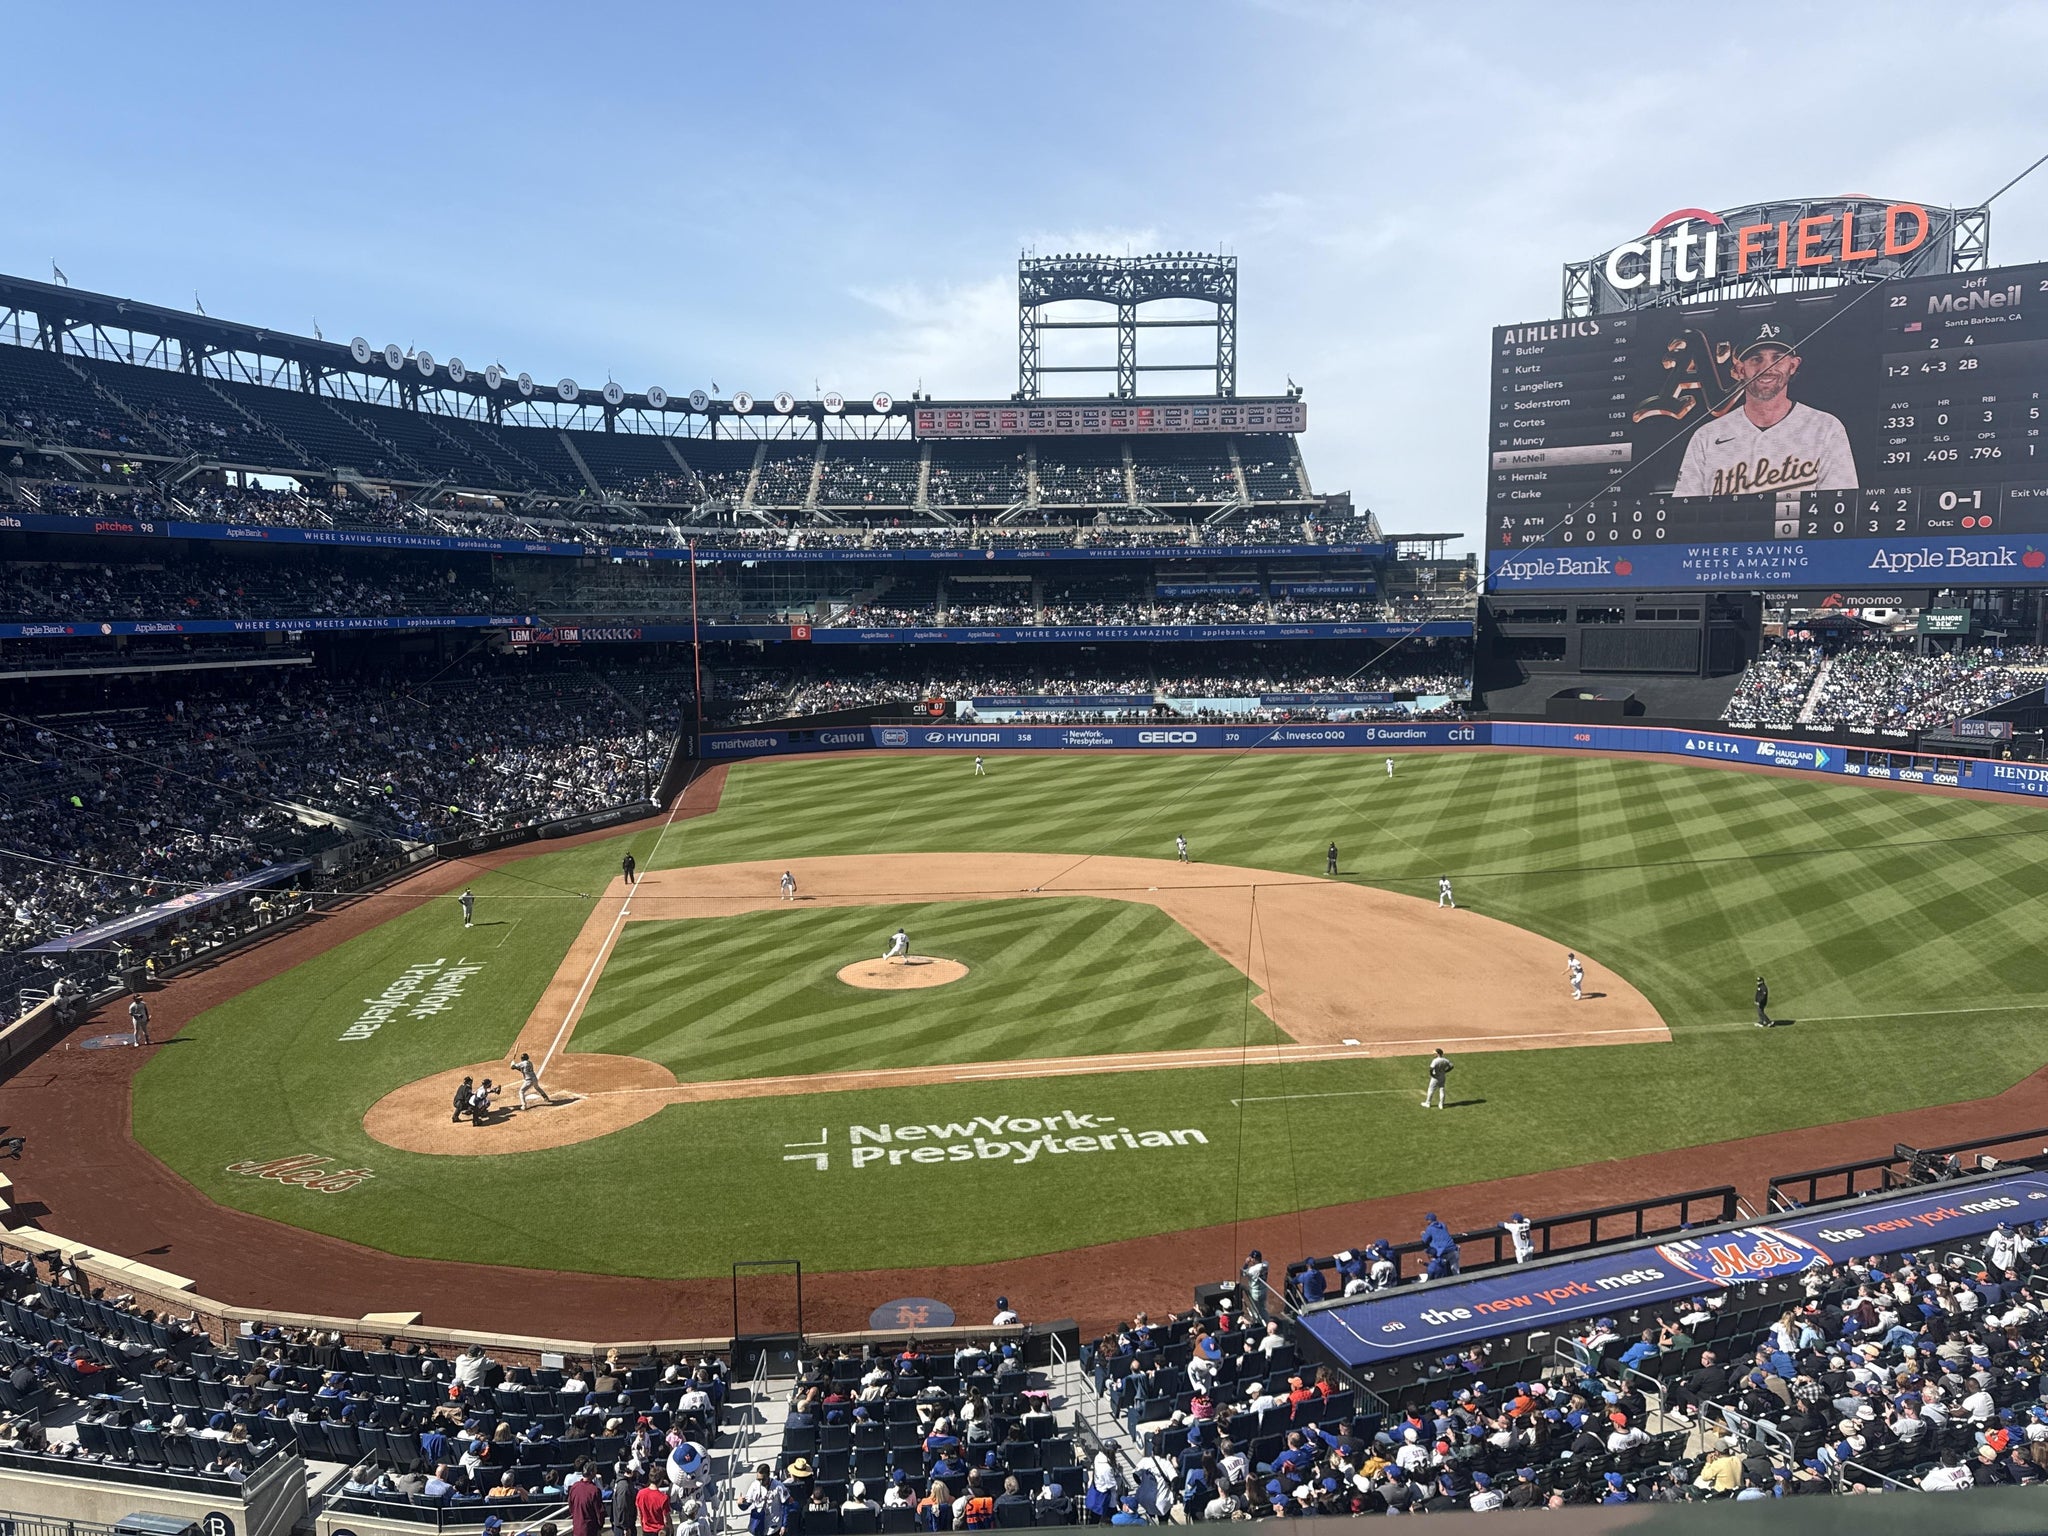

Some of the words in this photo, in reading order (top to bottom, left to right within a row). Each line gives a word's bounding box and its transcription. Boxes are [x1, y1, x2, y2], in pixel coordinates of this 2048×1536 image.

[1605, 208, 1718, 290] citi
[1738, 204, 1929, 275] FIELD
[1962, 277, 1987, 288] Jeff
[1890, 297, 1907, 307] 22
[1928, 285, 2021, 314] McNeil
[1971, 316, 2006, 325] Barbara,
[1930, 339, 1939, 348] 2
[1965, 335, 1974, 345] 4
[358, 345, 364, 356] 5
[1516, 346, 1544, 355] Butler
[389, 352, 398, 363] 18
[421, 358, 430, 369] 16
[1888, 366, 1909, 376] 1-2
[1921, 362, 1946, 373] 4-3
[1959, 359, 1978, 370] 2B
[452, 365, 462, 376] 24
[489, 372, 496, 383] 17
[521, 379, 529, 389] 36
[564, 385, 573, 394] 31
[1515, 381, 1563, 393] Langeliers
[609, 389, 618, 398] 41
[652, 393, 661, 402] 14
[694, 396, 704, 406] 37
[826, 399, 841, 407] SHEA
[877, 398, 888, 408] 42
[1514, 399, 1570, 410] Soderstrom
[1514, 419, 1545, 428] Cortes
[1884, 416, 1914, 428] .333
[1938, 414, 1948, 425] 0
[1983, 411, 1992, 422] 3
[2030, 408, 2039, 418] 5
[1513, 437, 1544, 446] Muncy
[1513, 454, 1545, 463] McNeil
[1883, 452, 1910, 464] .391
[1924, 450, 1958, 461] .405
[1970, 447, 2001, 459] .796
[2029, 445, 2034, 455] 1
[1512, 472, 1547, 481] Hernaiz
[1939, 491, 1981, 510] 0-1
[1564, 514, 1573, 524] 0
[1587, 513, 1596, 524] 0
[1612, 512, 1616, 522] 1
[1633, 511, 1642, 521] 0
[1656, 510, 1666, 520] 0
[1786, 505, 1789, 515] 1
[1808, 504, 1818, 514] 4
[1835, 503, 1845, 514] 0
[1870, 501, 1880, 512] 4
[1897, 500, 1907, 511] 2
[96, 522, 133, 533] pitches
[141, 523, 153, 532] 98
[1564, 531, 1572, 542] 0
[1587, 531, 1595, 541] 0
[1610, 530, 1618, 540] 0
[1633, 529, 1641, 539] 0
[1656, 528, 1665, 538] 0
[1782, 524, 1791, 534] 0
[1808, 523, 1817, 533] 2
[1834, 522, 1844, 533] 0
[1869, 521, 1878, 532] 3
[1896, 520, 1905, 531] 2
[457, 541, 501, 549] applebank.com
[1688, 548, 1738, 556] WHERE
[1747, 546, 1804, 555] SAVING
[1683, 559, 1729, 568] MEETS
[1737, 558, 1808, 567] AMAZING
[1868, 549, 1943, 573] Apple
[1946, 546, 2017, 567] Bank
[1497, 559, 1554, 580] Apple
[1557, 557, 1610, 575] Bank
[1696, 570, 1790, 581] applebank.com
[1847, 595, 1902, 605] moomoo
[235, 621, 269, 629] WHERE
[511, 630, 529, 641] LGM
[560, 629, 578, 640] LGM
[796, 627, 806, 637] 6
[1202, 629, 1265, 637] applebank.com
[820, 733, 864, 744] Canon
[948, 733, 1000, 742] HYUNDAI
[1139, 732, 1197, 743] GEICO
[1286, 731, 1323, 740] Invesco
[1324, 731, 1344, 740] QQQ
[1378, 730, 1426, 738] Guardian
[1449, 726, 1474, 740] citi
[1574, 733, 1590, 741] 408
[712, 738, 768, 750] smartwater
[1070, 737, 1113, 745] Presbyterian
[1699, 741, 1739, 754] DELTA
[1776, 750, 1813, 760] HAUGLAND
[1775, 758, 1798, 766] GROUP
[1844, 764, 1860, 774] 380
[1868, 767, 1890, 776] GOYA
[1994, 766, 2048, 782] HENDR
[1900, 770, 1924, 780] GOYA
[1933, 773, 1957, 783] GOYA
[849, 1110, 1115, 1146] NewYork-
[852, 1125, 1209, 1169] Presbyterian
[226, 1153, 375, 1194] Mets
[2028, 1191, 2047, 1200] citi
[1818, 1227, 1866, 1244] the
[1863, 1216, 1915, 1234] new
[1912, 1206, 1966, 1228] york
[1960, 1194, 2020, 1216] mets
[1998, 1240, 2016, 1253] 34
[1709, 1239, 1802, 1278] Mets
[1421, 1306, 1472, 1326] the
[1474, 1295, 1530, 1314] new
[1534, 1281, 1598, 1305] york
[1596, 1267, 1665, 1290] mets
[1382, 1321, 1405, 1333] citi
[209, 1518, 226, 1536] B
